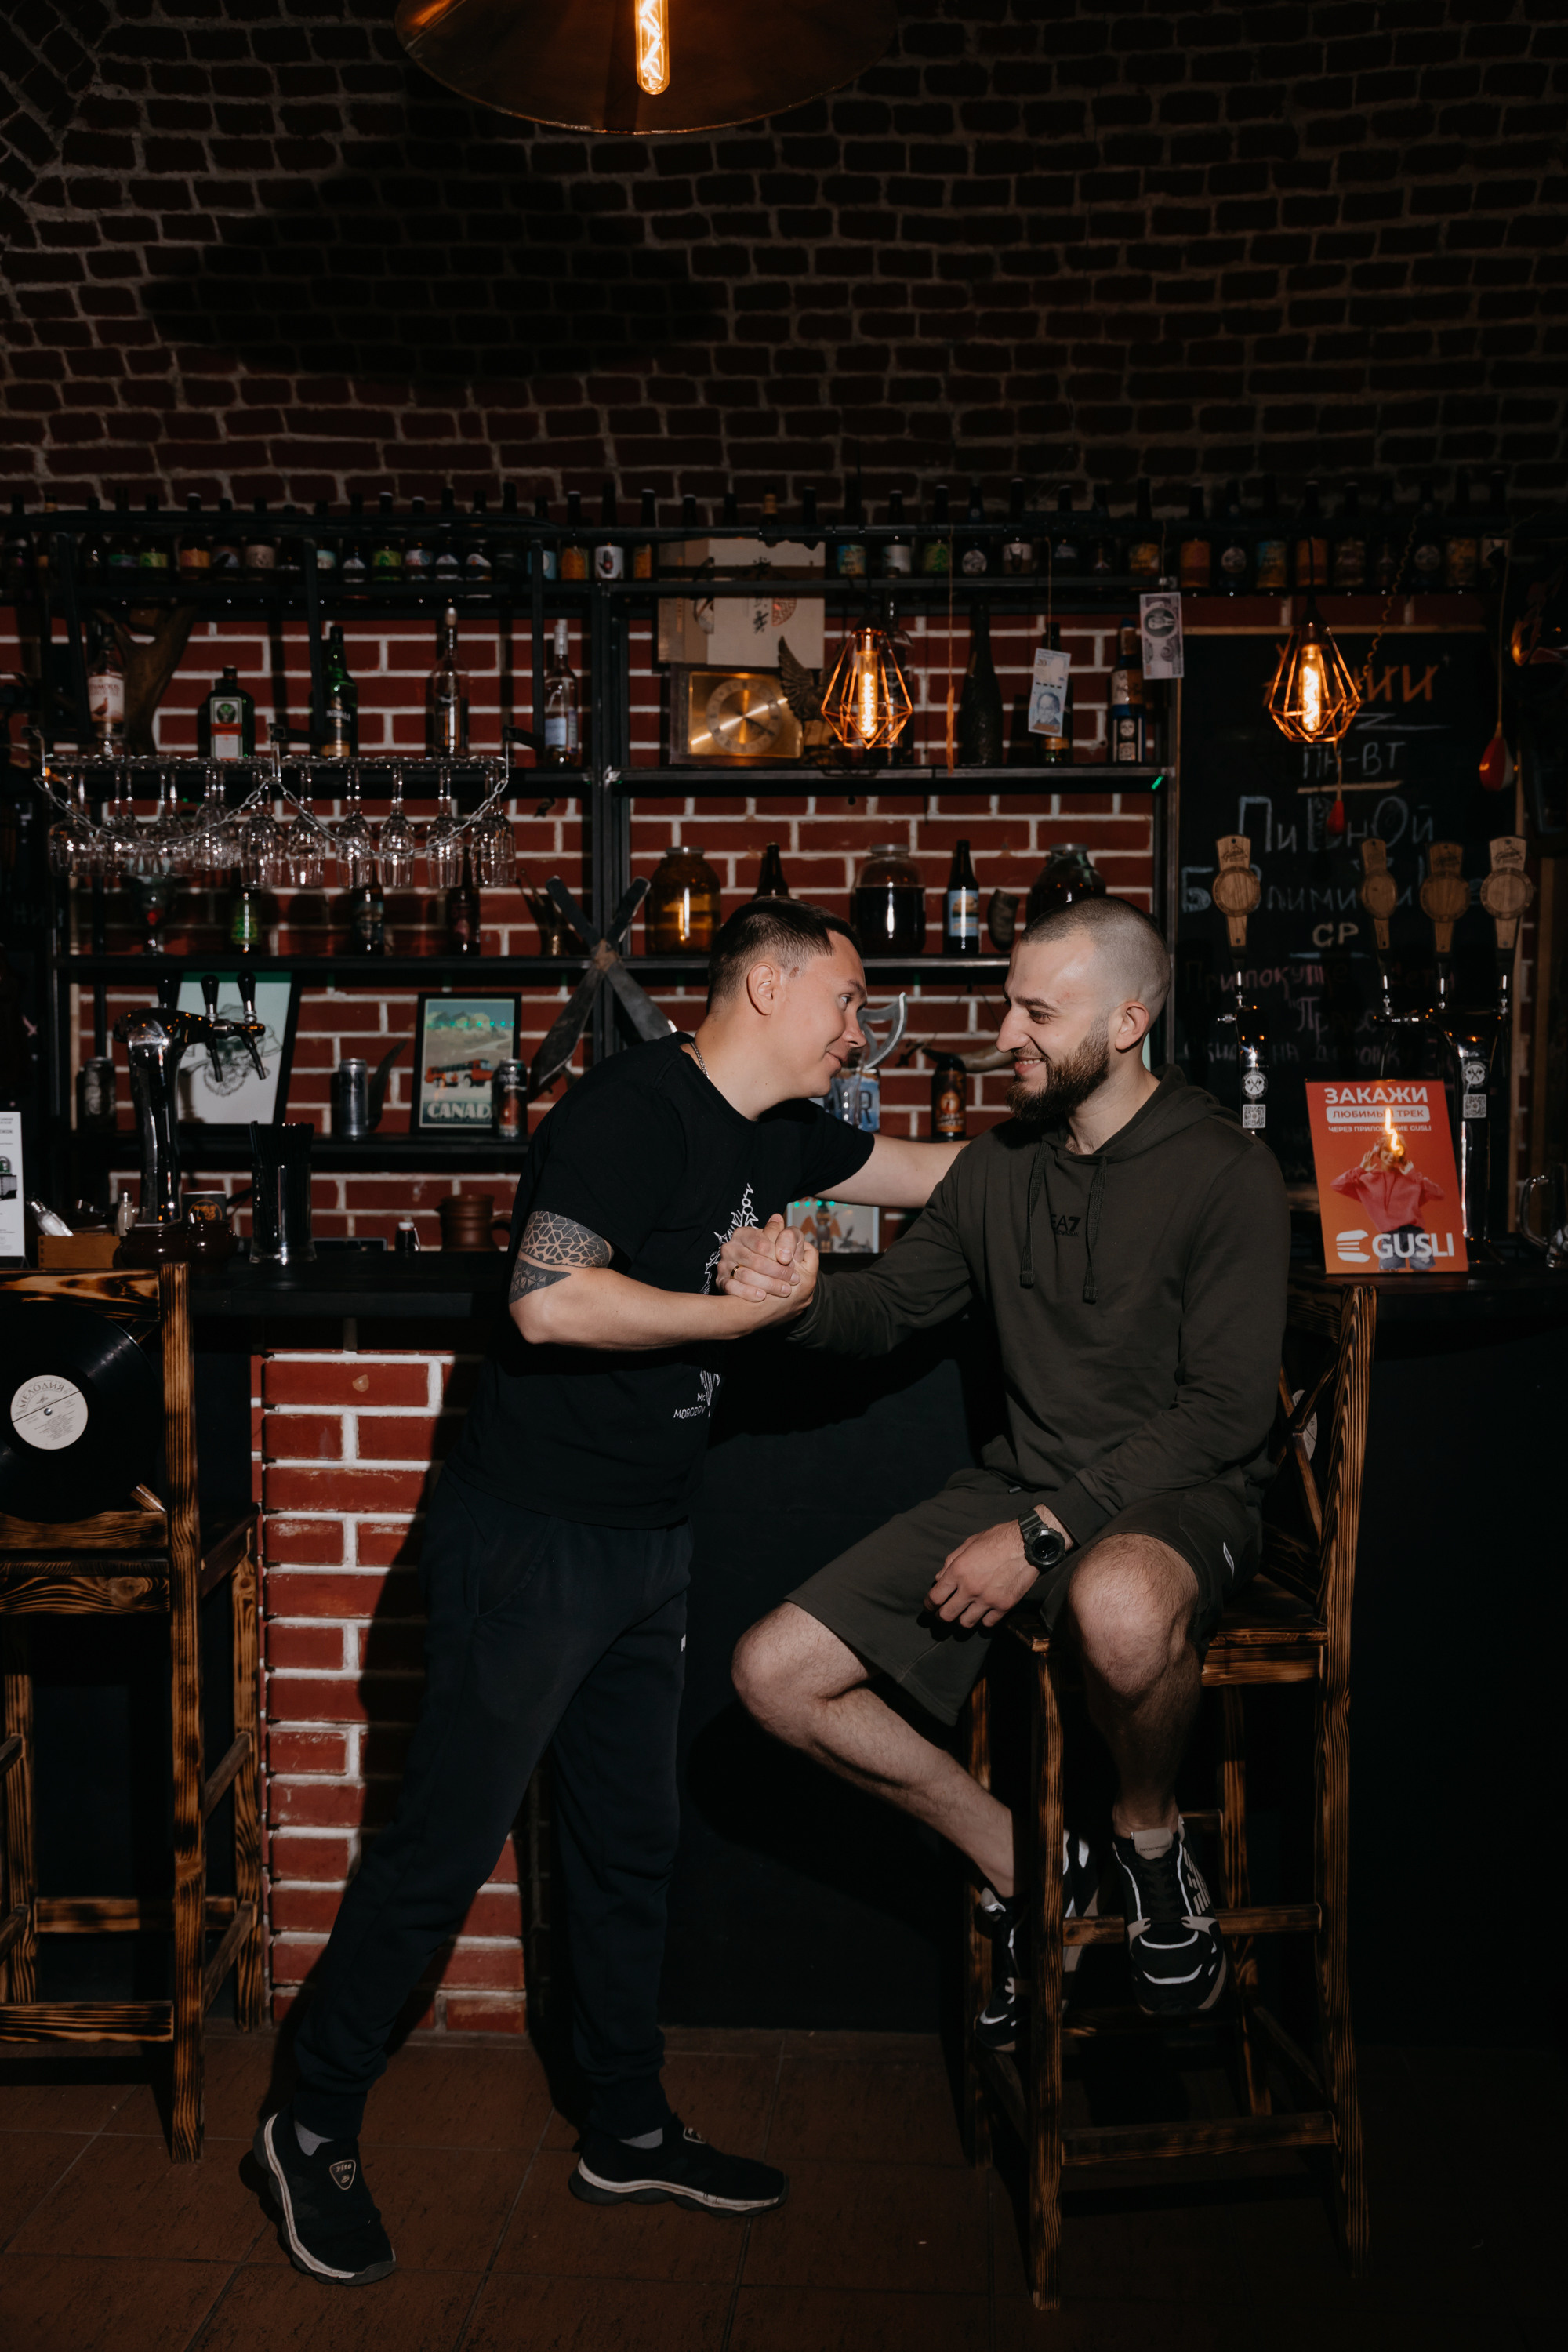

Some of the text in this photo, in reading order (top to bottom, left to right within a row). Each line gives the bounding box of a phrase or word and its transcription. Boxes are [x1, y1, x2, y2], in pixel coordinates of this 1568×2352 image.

[1323, 1087, 1428, 1105] ЗАКАЖИ
[427, 1102, 493, 1119] CANAD
[1333, 1109, 1425, 1119] ЛЮБИМЫ ТРЕК
[1372, 1232, 1455, 1258] GUSLI
[18, 1381, 64, 1409] МЕЛОДИЯ
[673, 1405, 706, 1420] MOROZOV
